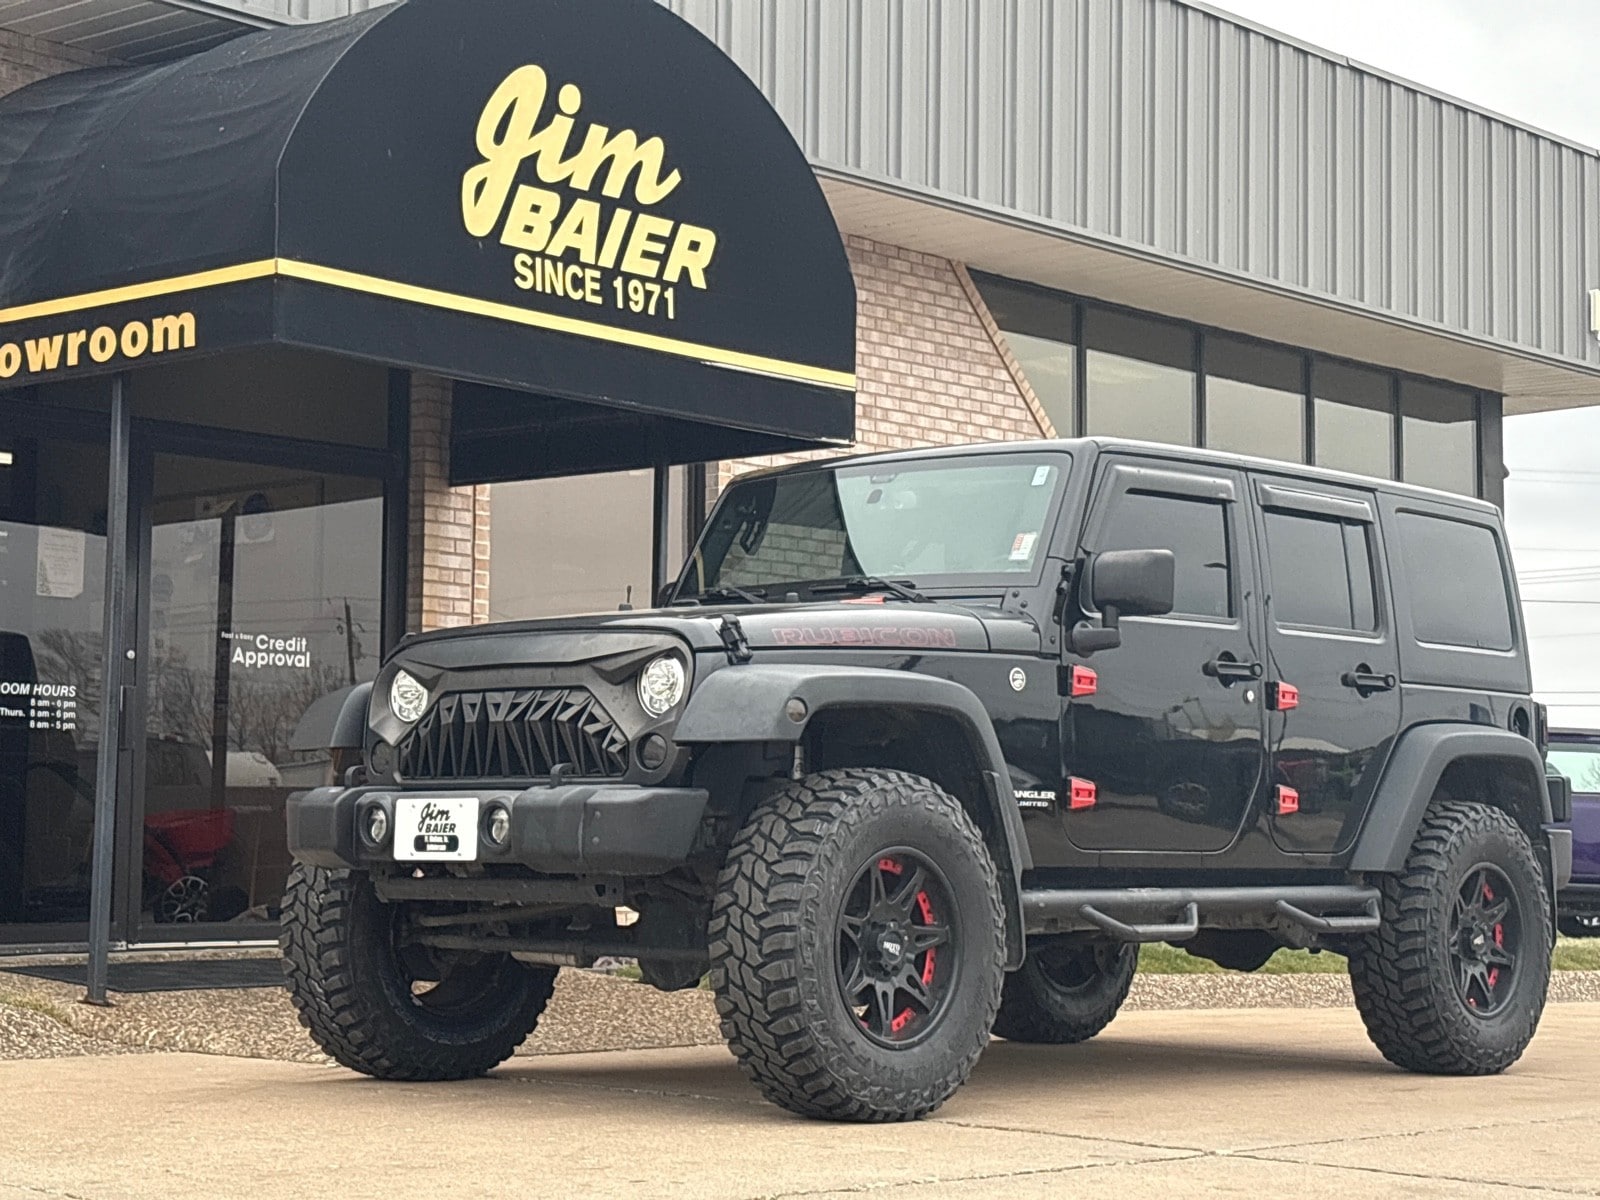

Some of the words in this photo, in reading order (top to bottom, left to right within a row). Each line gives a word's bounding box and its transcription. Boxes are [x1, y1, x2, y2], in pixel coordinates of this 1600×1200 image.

[462, 64, 682, 237] Jim
[499, 184, 717, 290] BAIER
[513, 253, 603, 305] SINCE
[612, 276, 675, 320] 1971
[0, 311, 196, 378] owroom
[256, 634, 307, 652] Credit
[771, 627, 957, 647] RUBICON
[231, 646, 311, 669] Approval
[32, 684, 77, 698] HOURS
[37, 699, 50, 707] am
[63, 701, 77, 709] pm
[37, 709, 50, 717] am
[62, 711, 76, 720] pm
[36, 721, 49, 729] am
[62, 722, 76, 731] pm
[418, 802, 451, 832] Jim
[425, 823, 456, 833] BAIER
